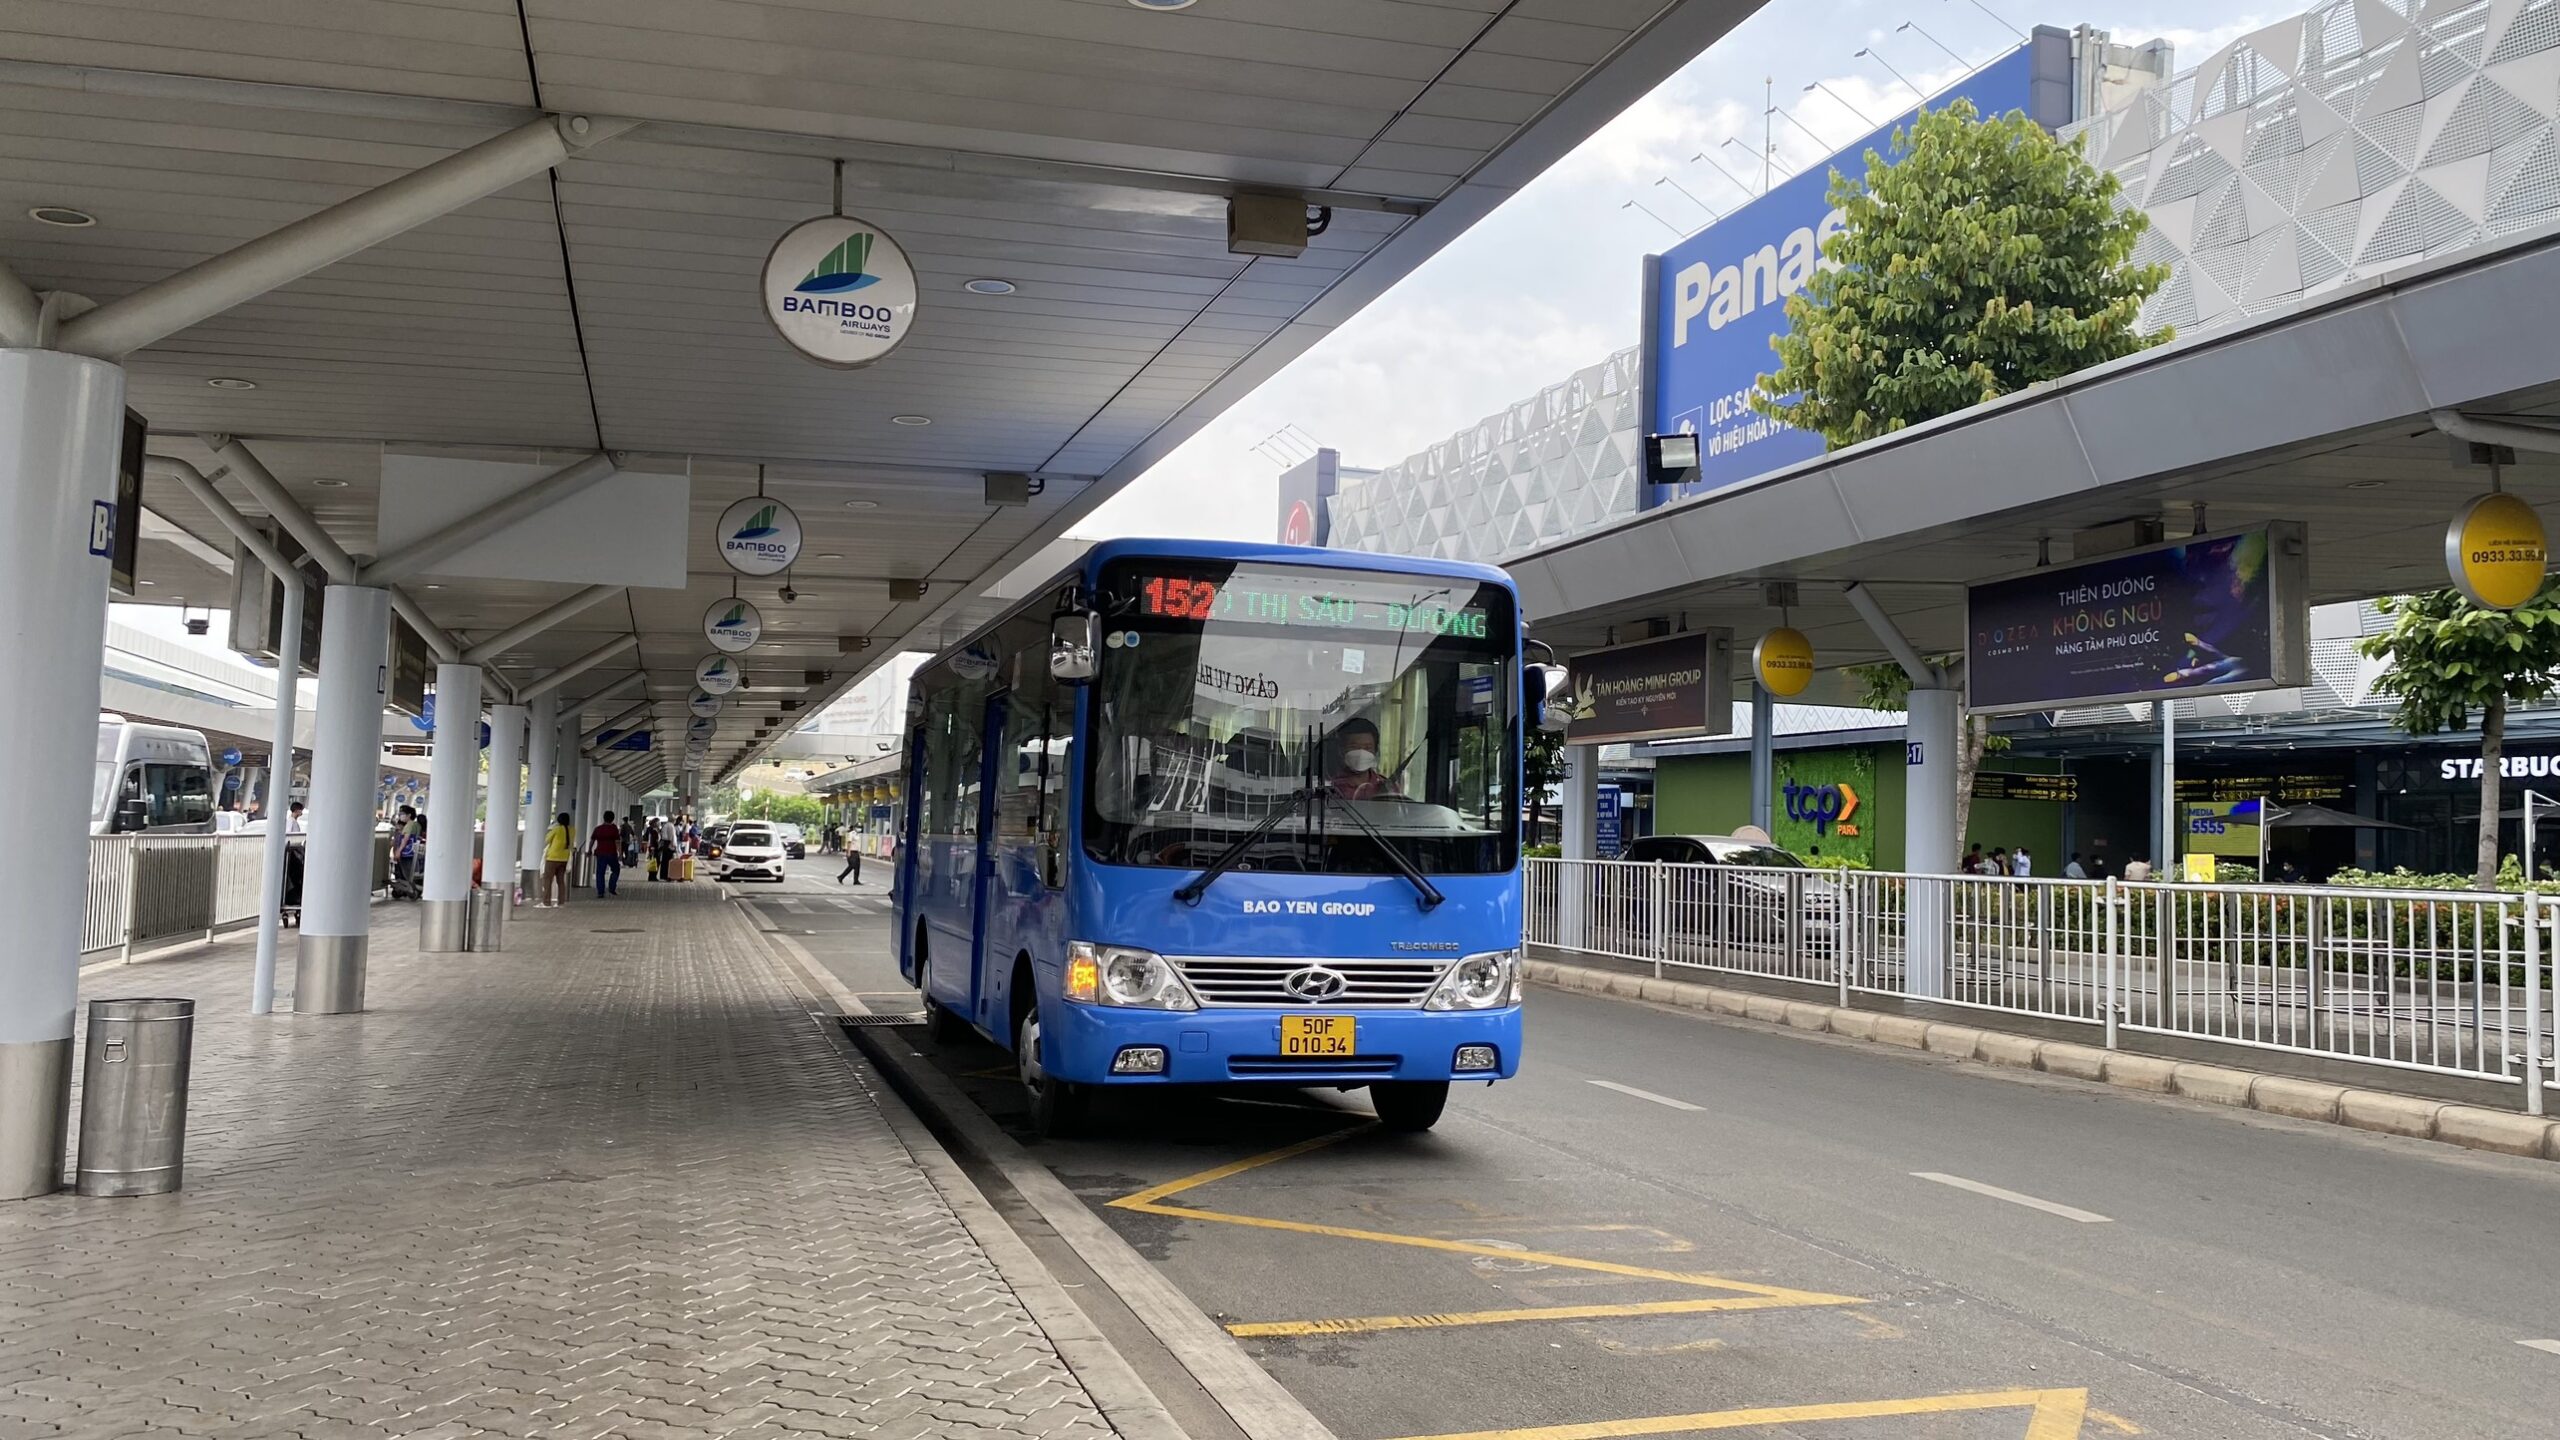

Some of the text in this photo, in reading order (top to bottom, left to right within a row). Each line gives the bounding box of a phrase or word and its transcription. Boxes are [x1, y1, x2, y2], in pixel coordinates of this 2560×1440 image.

[1674, 205, 1852, 349] Panas
[783, 296, 892, 322] BAMBOO
[841, 320, 891, 333] AIRWAYS
[1709, 394, 1733, 428] LỌC
[1708, 431, 1721, 457] VÔ
[1722, 424, 1746, 453] HIỆU
[1746, 416, 1768, 444] HÓA
[726, 541, 786, 553] BAMBOO
[1145, 576, 1216, 617] 152
[2058, 576, 2155, 607] THIÊN ĐƯỜNG
[2052, 594, 2162, 637] KHÔNG NGỦ
[710, 628, 752, 638] BAMBOO
[2055, 641, 2083, 656] NÂNG
[2085, 636, 2105, 652] TẦM
[2129, 627, 2160, 645] QUỐC
[1596, 668, 1702, 697] TÂN HOÀNG MINH GROUP
[1562, 763, 1573, 778] -16
[1783, 777, 1842, 837] tcp
[1837, 824, 1859, 837] PARK
[1243, 900, 1376, 917] BAO YEN GROUP
[1303, 1018, 1335, 1035] 50F
[1289, 1036, 1347, 1054] 010.34
